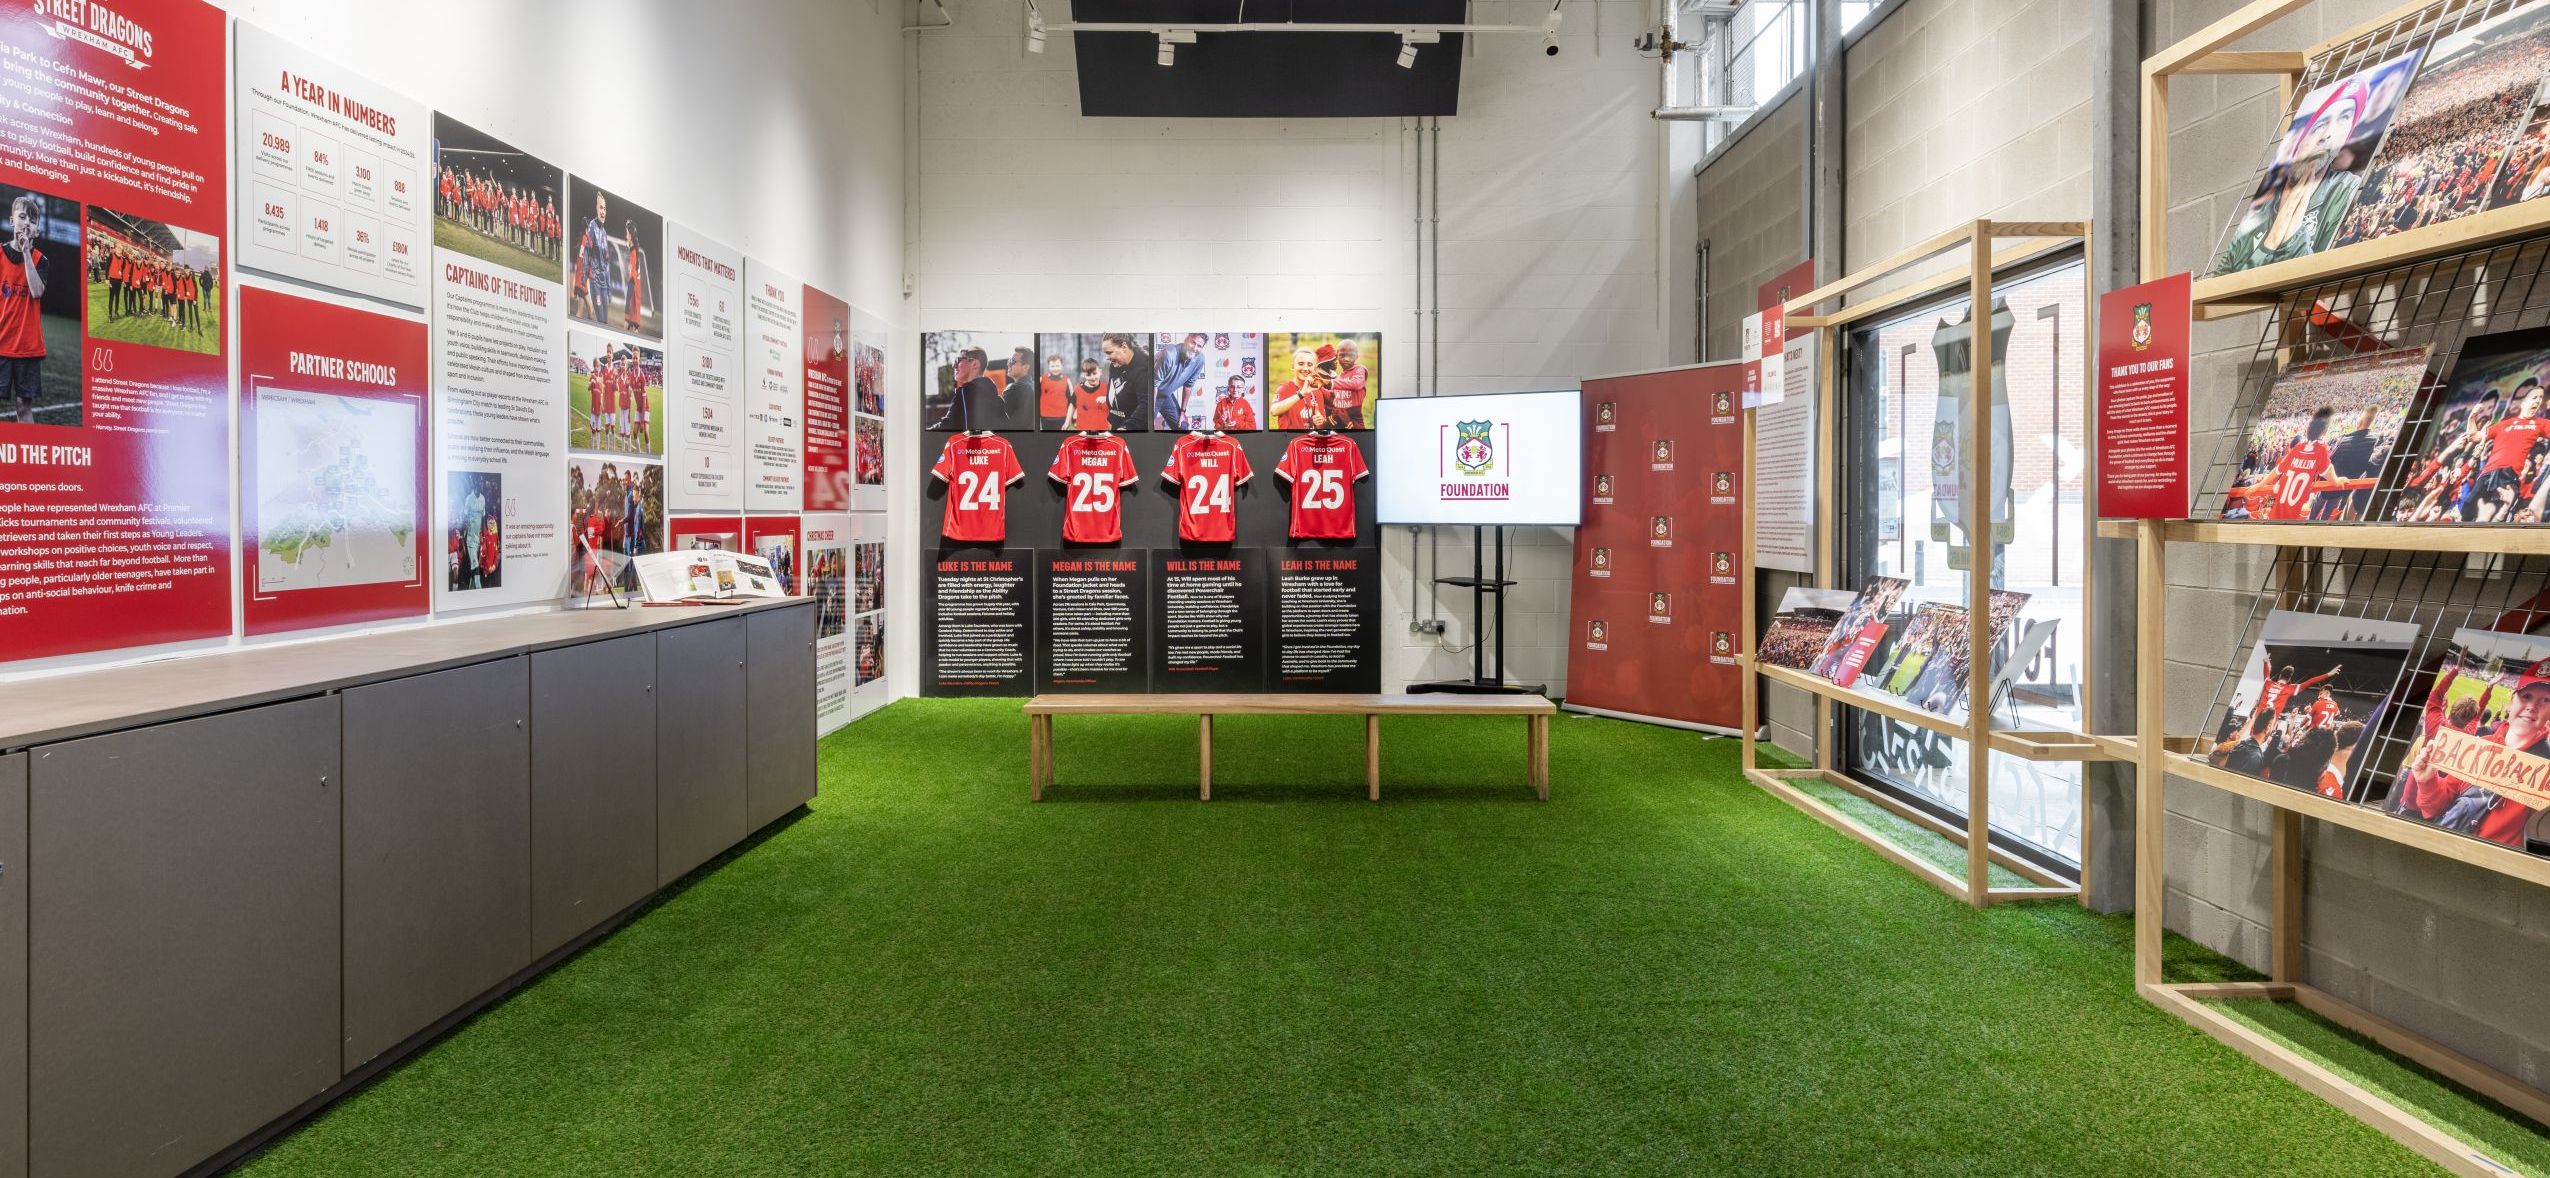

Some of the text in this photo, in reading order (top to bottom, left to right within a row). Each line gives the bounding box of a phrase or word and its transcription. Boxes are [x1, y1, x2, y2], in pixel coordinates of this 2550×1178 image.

[63, 25, 128, 57] WREXHAM AFC
[91, 2, 152, 57] DRAGONS
[13, 47, 190, 118] Park to Cefn Mawr, our Street Dragons
[3, 58, 198, 134] bring the community together. Creating safe
[3, 78, 160, 136] young people to play, learn and belong.
[281, 71, 395, 136] A YEAR IN NUMBERS
[22, 102, 73, 126] Connection
[262, 132, 290, 154] 20,989
[5, 158, 70, 184] and belonging.
[36, 152, 192, 204] More than just a kickabout, it's friendship,
[678, 245, 736, 281] MOMENTS THAT MATTERED
[446, 264, 546, 308] CAPTAINS OF THE FUTURE
[290, 351, 396, 386] PARTNER SCHOOLS
[2112, 358, 2174, 378] THANK YOU TO OUR FANS
[20, 444, 92, 466] THE PITCH
[970, 456, 988, 465] LUKE
[1082, 457, 1108, 466] MEGAN
[1200, 459, 1218, 467] WILL
[1314, 455, 1333, 463] LEAH
[2290, 457, 2316, 470] MULLIN
[29, 482, 84, 492] opens doors.
[958, 471, 1000, 510] 24
[1072, 472, 1115, 512] 25
[1188, 474, 1231, 514] 24
[1301, 469, 1344, 509] 25
[1441, 484, 1509, 496] FOUNDATION
[2280, 469, 2310, 506] 10
[24, 504, 153, 514] have represented Wrexham AFC
[938, 562, 1013, 571] LUKE IS THE NAME
[1053, 561, 1136, 571] MEGAN IS THE NAME
[1167, 561, 1241, 571] WILL IS THE NAME
[1282, 560, 1357, 570] LEAH IS THE NAME
[1710, 655, 1735, 663] FOUNDATION
